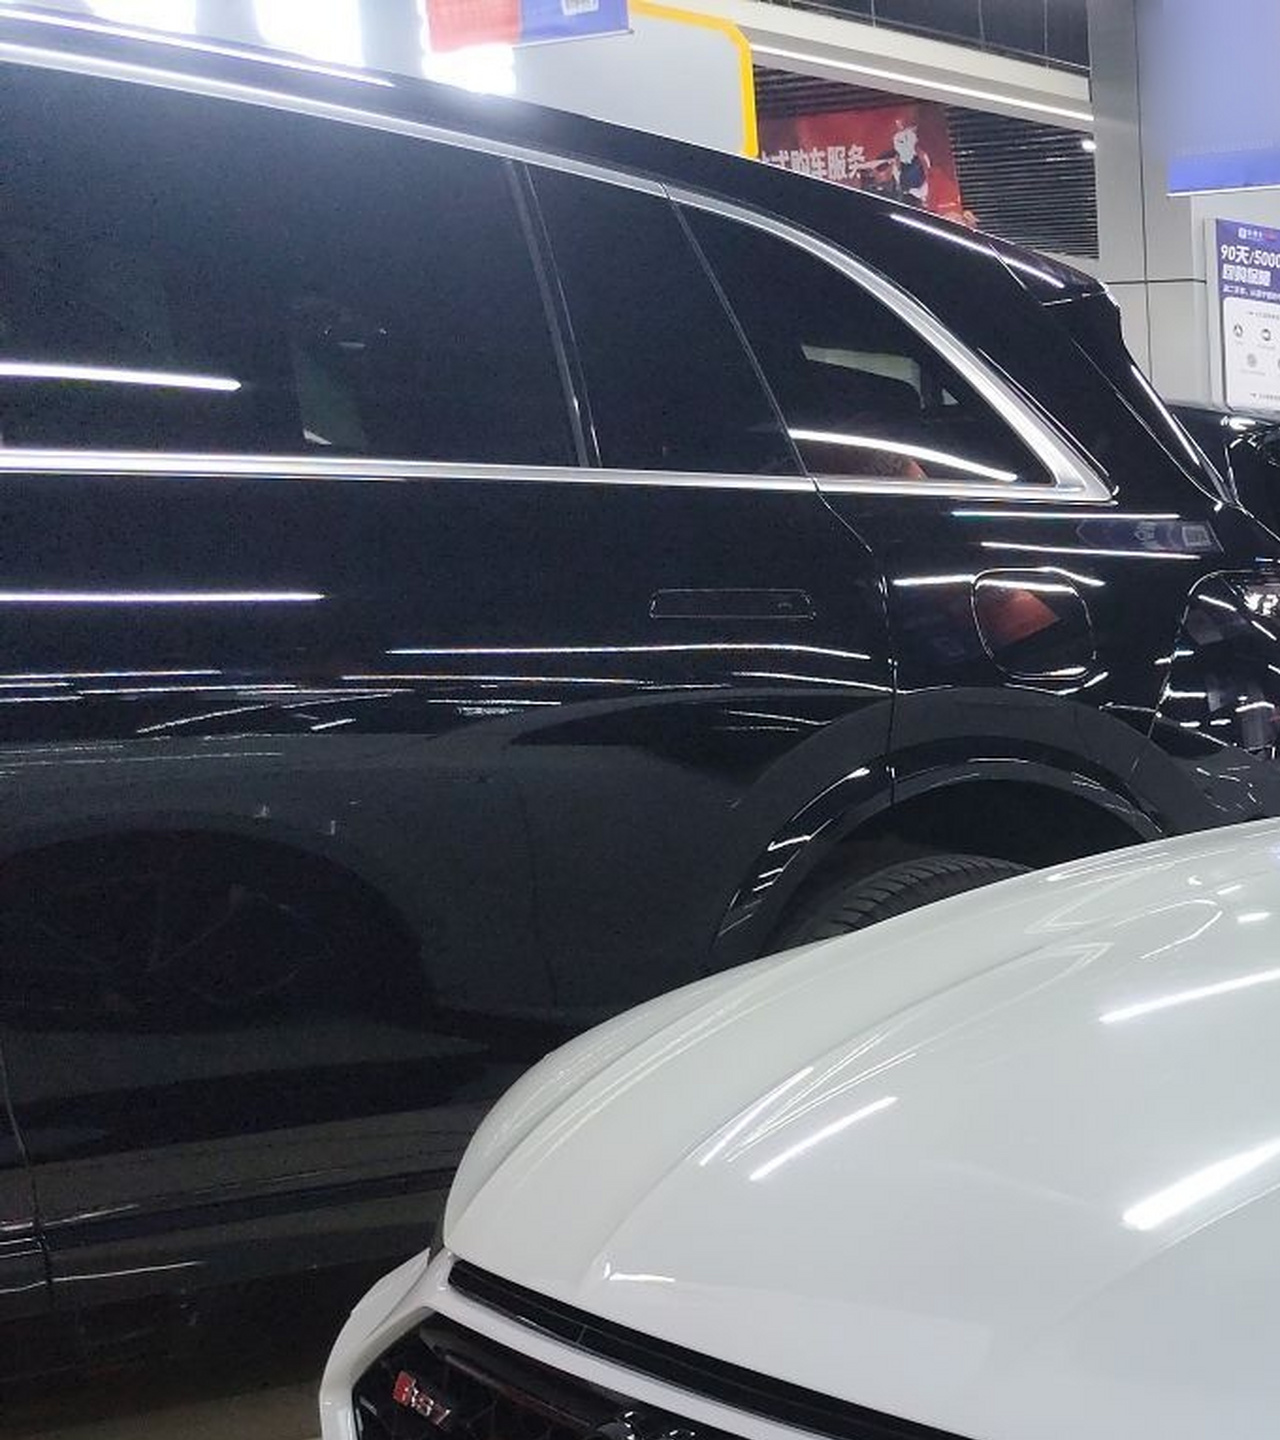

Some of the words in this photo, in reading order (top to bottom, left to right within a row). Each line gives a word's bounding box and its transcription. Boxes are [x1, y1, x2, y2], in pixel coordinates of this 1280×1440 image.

[761, 145, 866, 181] 式购车服务
